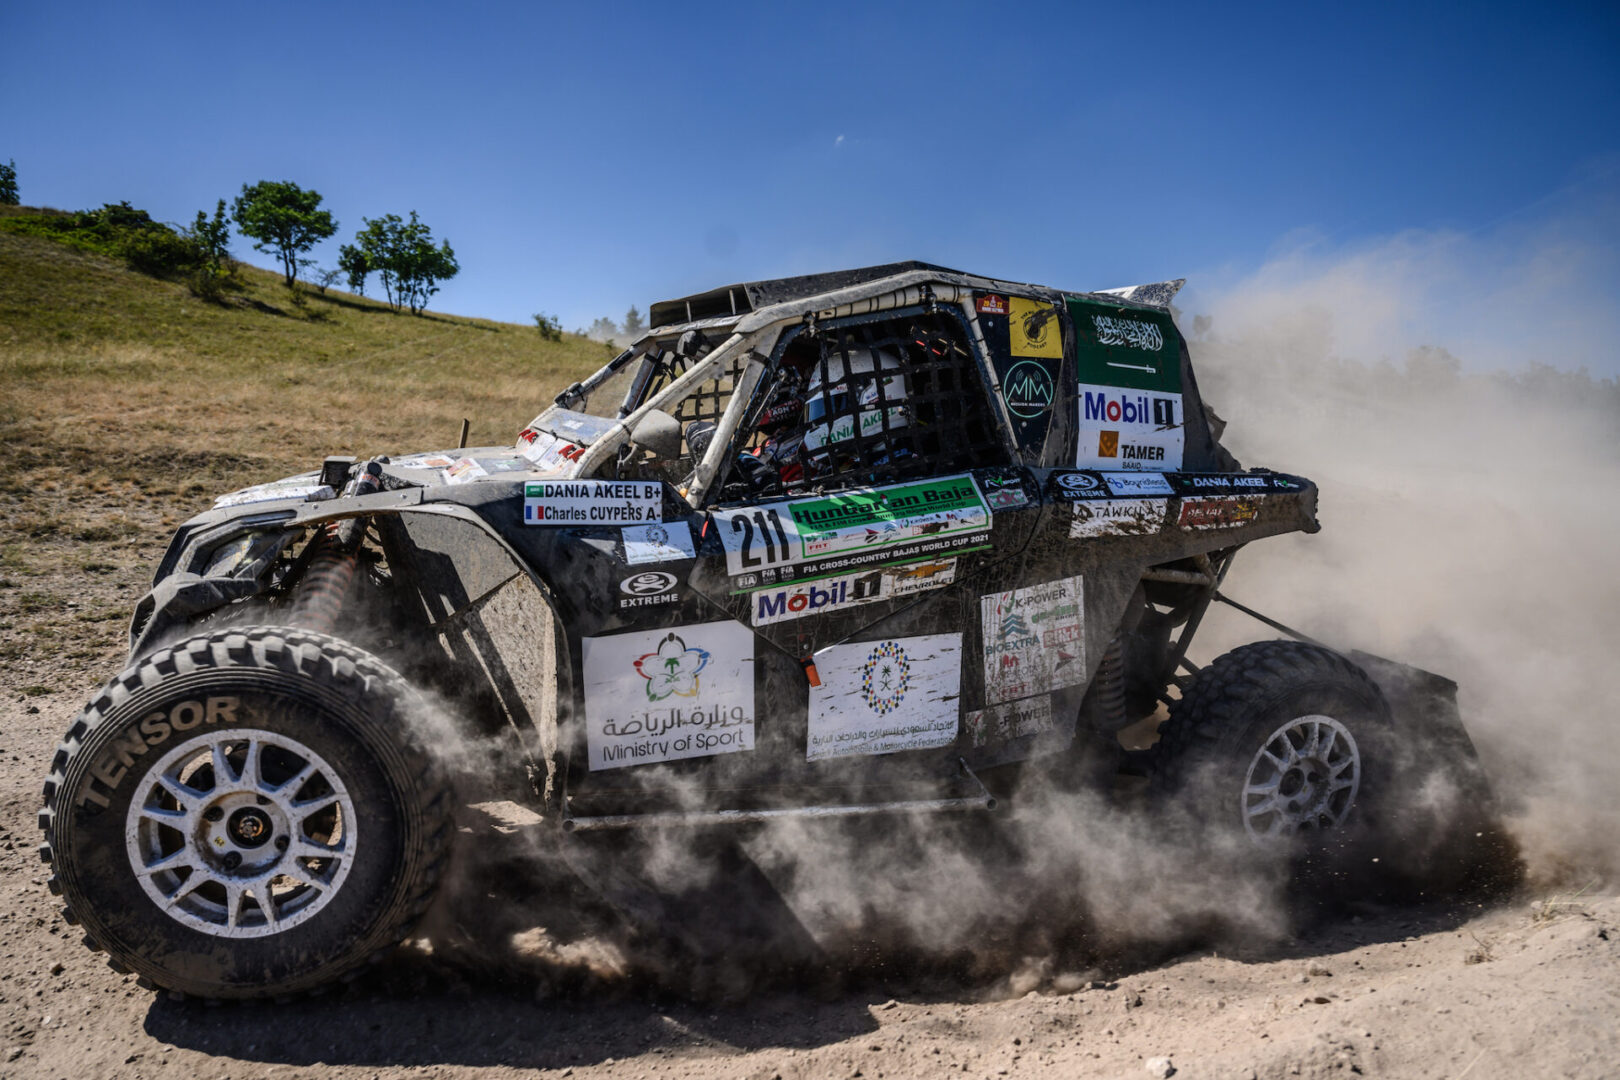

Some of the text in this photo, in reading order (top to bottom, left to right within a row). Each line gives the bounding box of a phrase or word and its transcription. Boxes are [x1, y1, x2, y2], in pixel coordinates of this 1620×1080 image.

[1085, 392, 1167, 424] Mobil 1
[1121, 445, 1164, 460] TAMER
[545, 484, 661, 499] DANIA AKEEL B+
[1193, 478, 1230, 487] DANIA
[1234, 478, 1268, 487] AKEEL
[922, 486, 975, 502] Baja
[545, 506, 661, 520] Charles CUYPERS A-
[731, 508, 789, 567] 211
[803, 534, 989, 574] FIA CROSS-COUNTRY BAJAS WORLD CUP 2021
[738, 576, 755, 587] FIA
[620, 593, 678, 608] EXTREME
[758, 581, 846, 620] Mobil
[1015, 588, 1067, 608] K-POWER
[985, 635, 1040, 655] BIOEXTRA
[603, 704, 744, 737] وزارة الرياضة
[76, 696, 241, 810] TENSOR
[603, 729, 744, 762] Ministry of Sport
